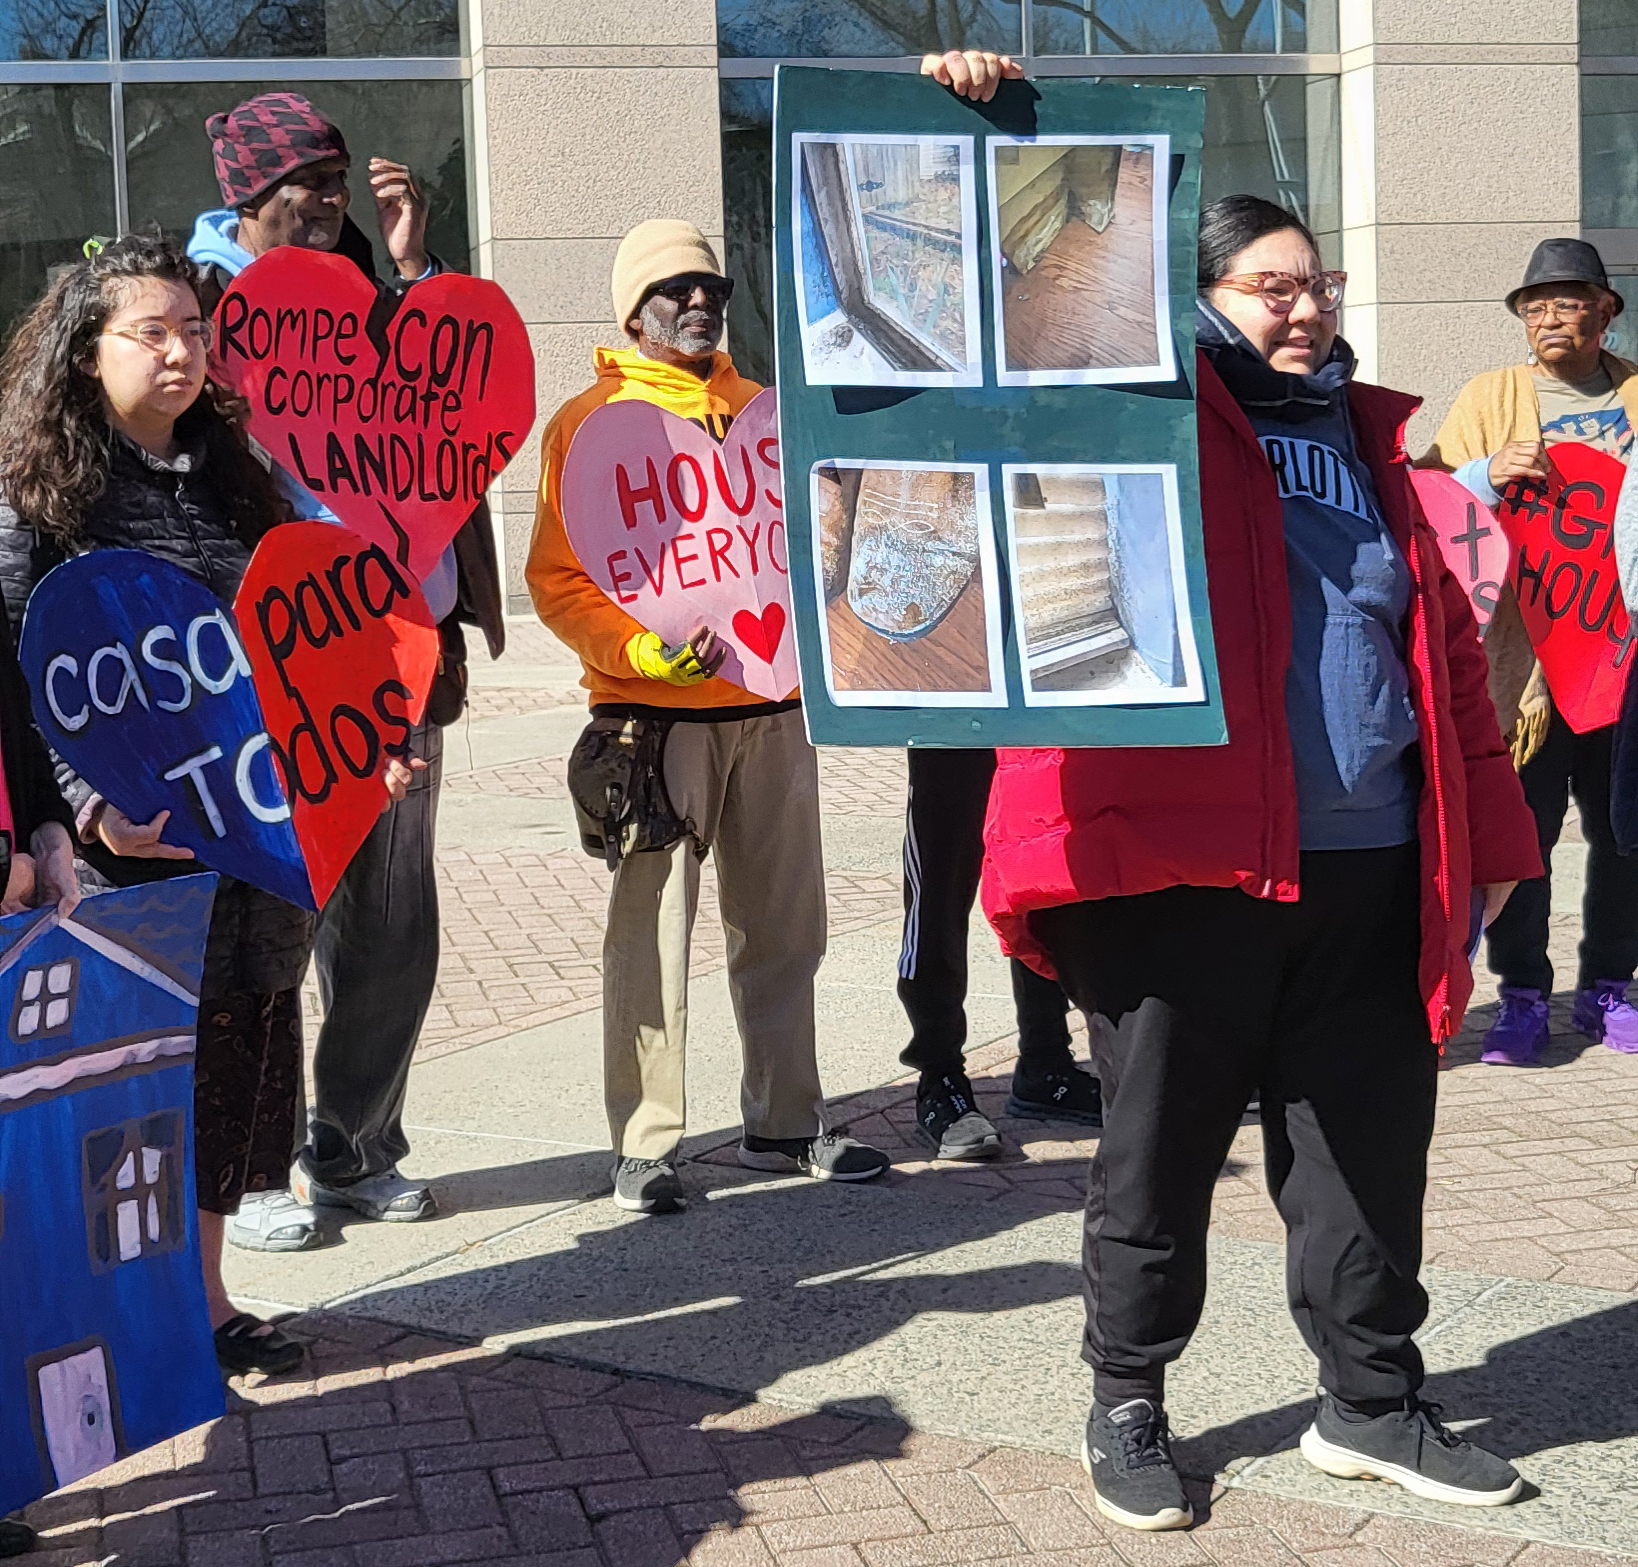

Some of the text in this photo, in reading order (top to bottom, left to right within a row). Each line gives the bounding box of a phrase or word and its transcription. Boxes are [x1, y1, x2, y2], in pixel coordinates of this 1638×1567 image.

[264, 366, 463, 436] corporate
[45, 542, 411, 733] casa para
